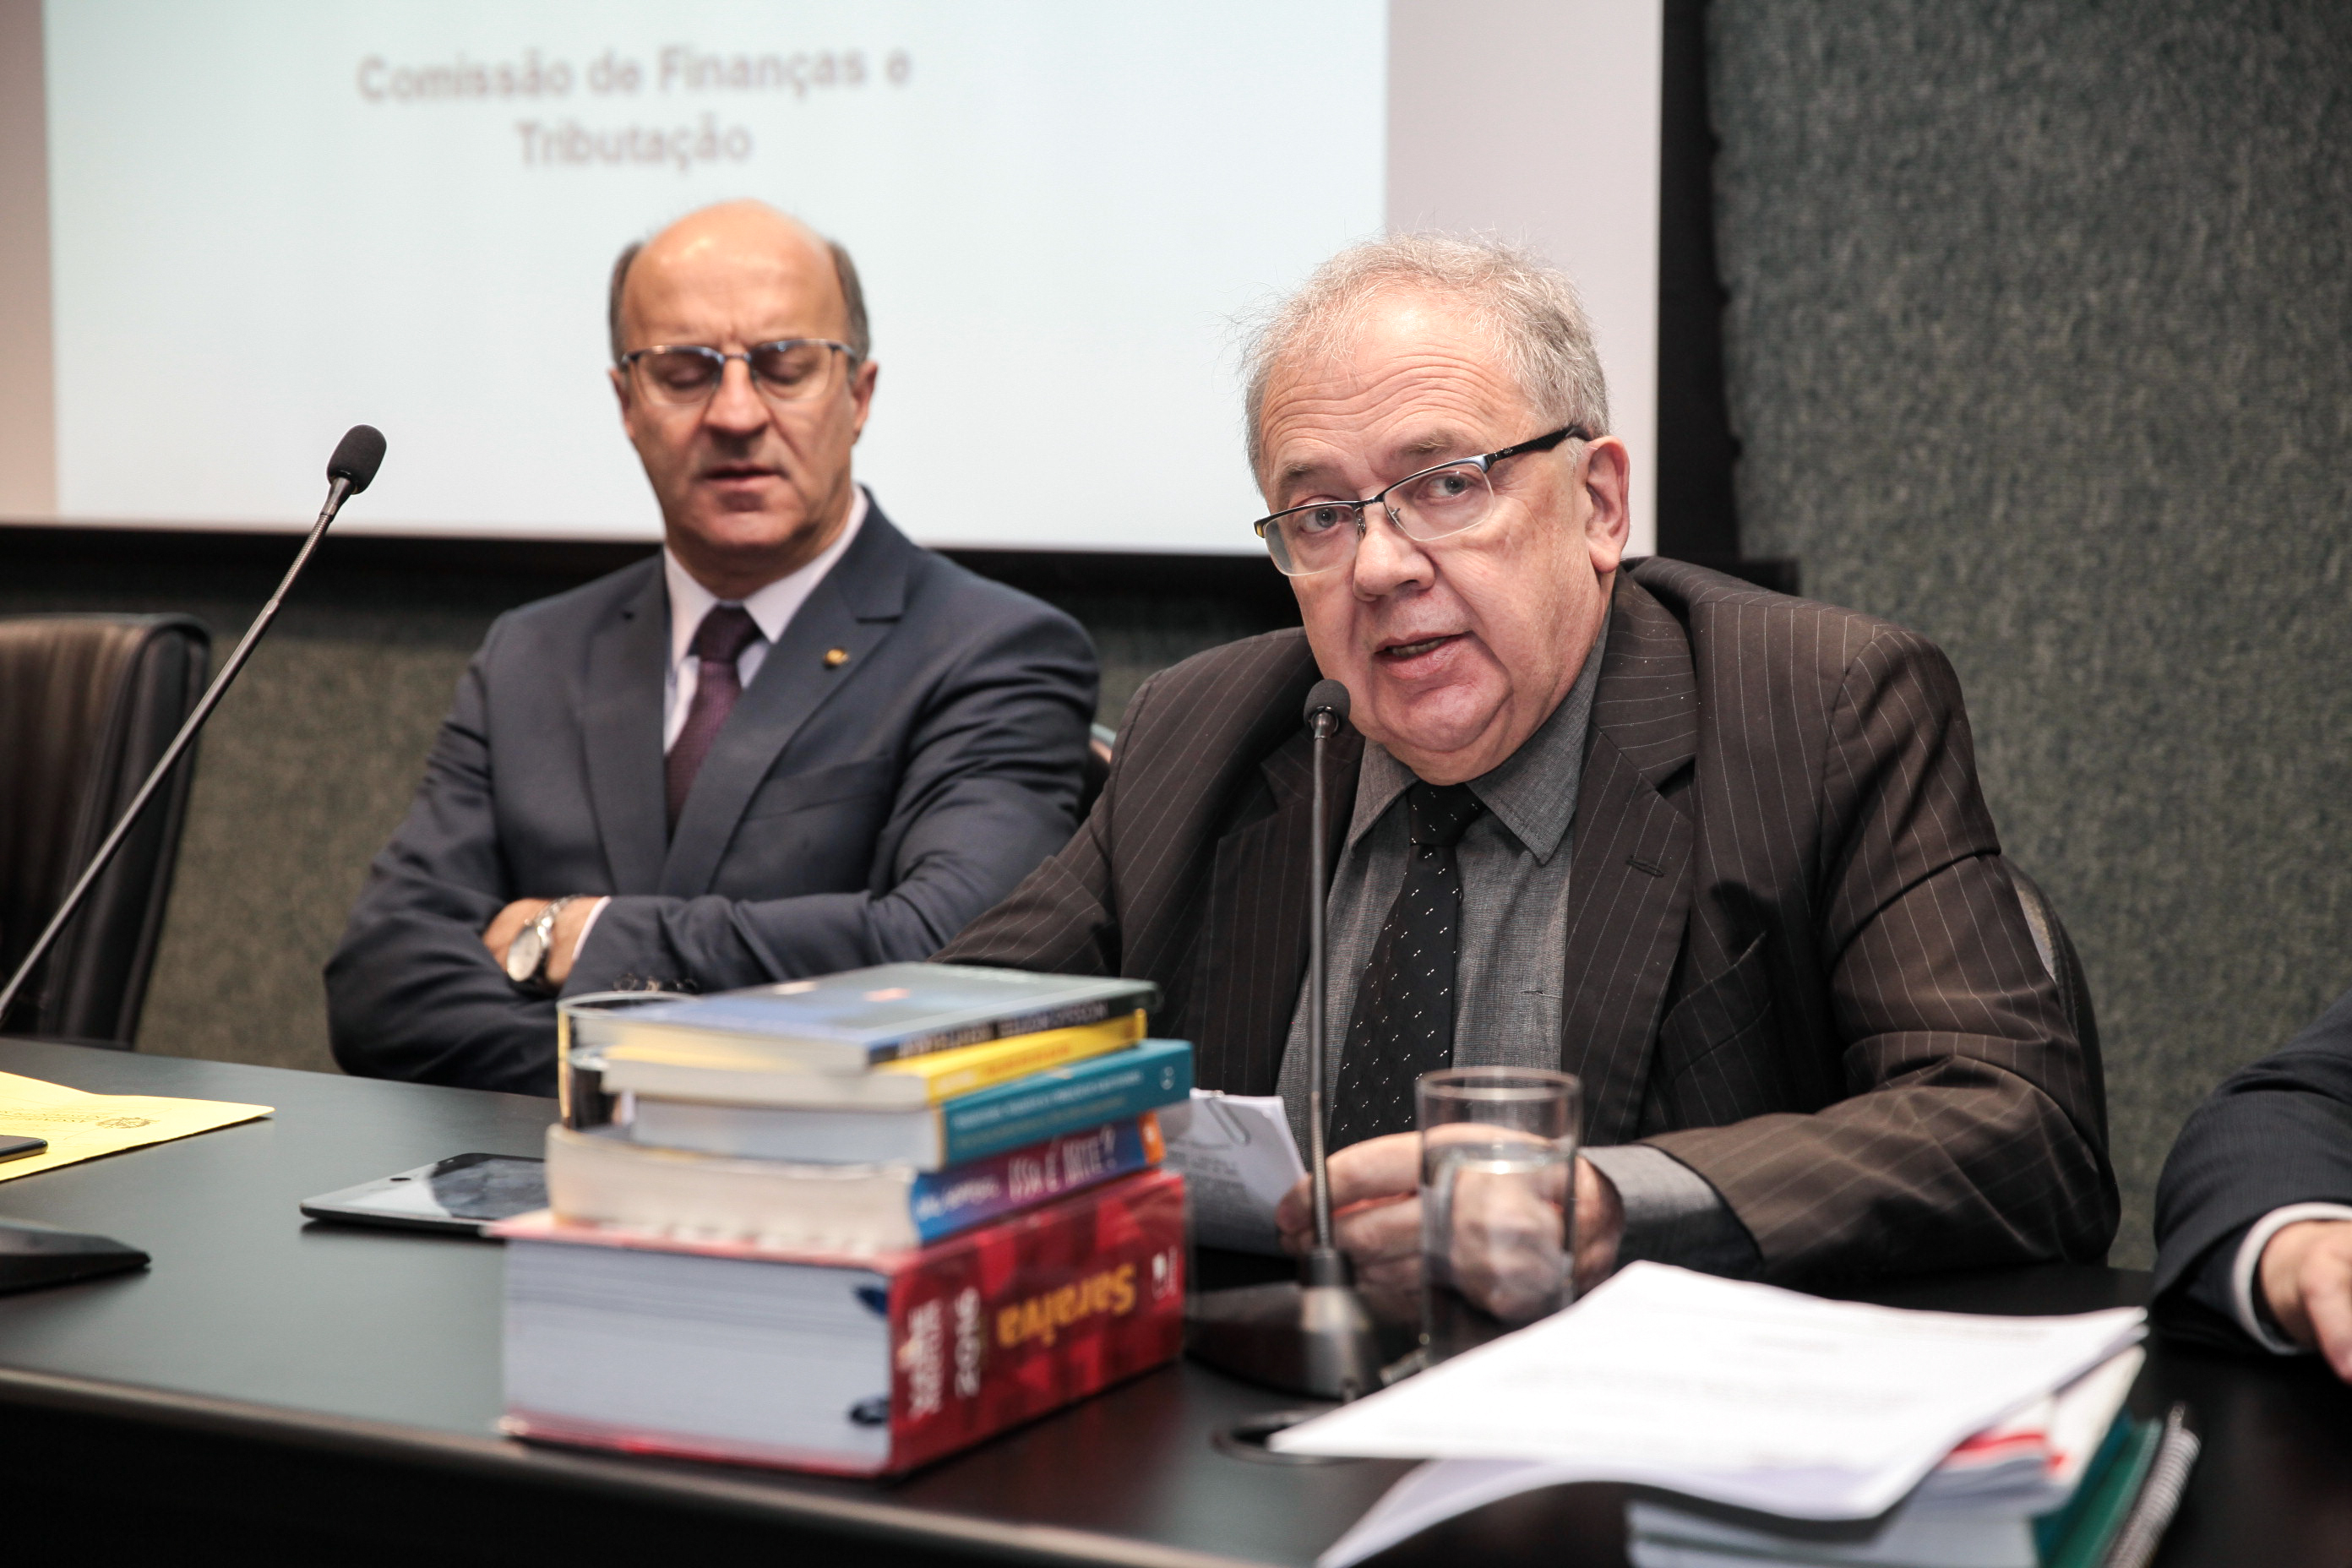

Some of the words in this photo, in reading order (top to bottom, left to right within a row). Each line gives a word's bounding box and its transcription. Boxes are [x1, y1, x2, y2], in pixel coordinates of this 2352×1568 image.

[357, 48, 574, 102] Comissão
[587, 51, 643, 95] de
[657, 46, 865, 101] Finanças
[885, 51, 912, 84] e
[515, 113, 752, 171] Tributação
[996, 1262, 1137, 1348] Saraiva
